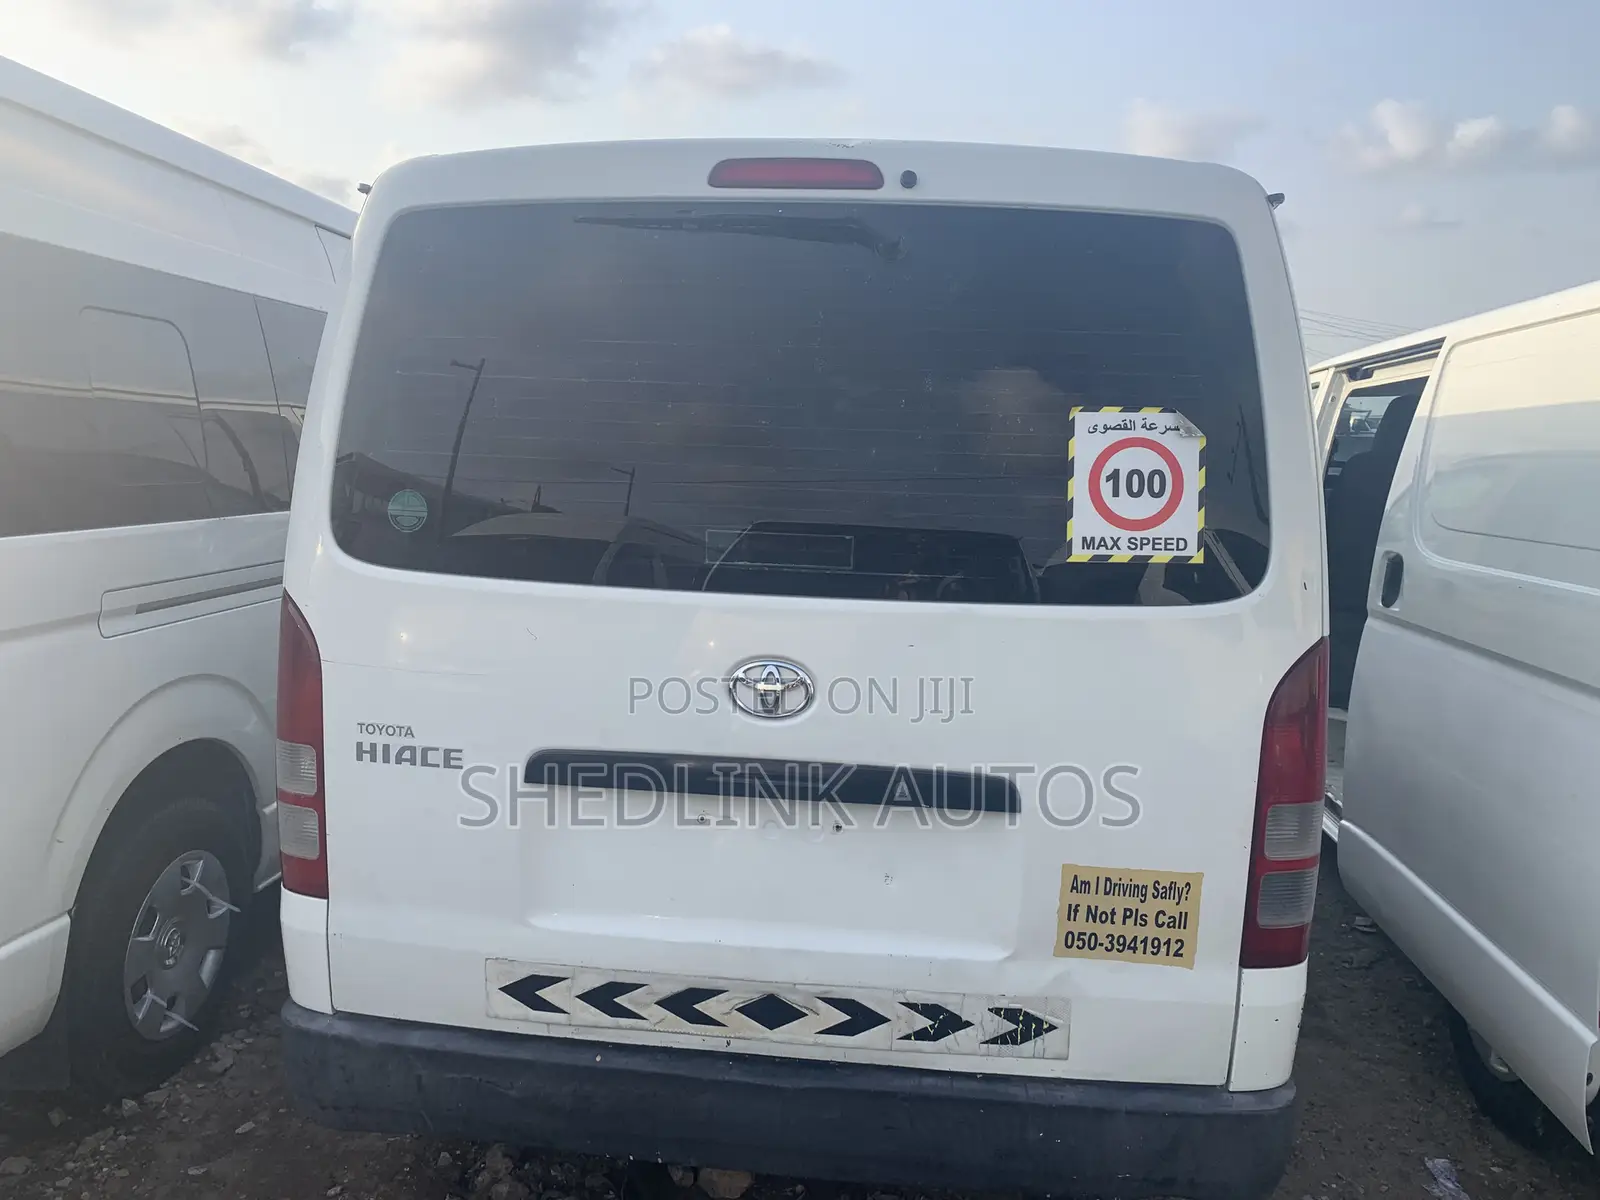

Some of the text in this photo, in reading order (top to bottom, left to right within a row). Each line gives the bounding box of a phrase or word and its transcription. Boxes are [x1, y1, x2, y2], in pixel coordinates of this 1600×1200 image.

[1088, 417, 1181, 435] سرعة القصوى
[1105, 468, 1167, 499] 100
[1081, 536, 1188, 552] MAX SPEED
[357, 722, 415, 738] TOYOTA
[356, 741, 464, 770] HIACE
[1070, 874, 1191, 906] Am I Driving Safly?
[1067, 903, 1189, 930] If Not Pls Call
[1064, 931, 1185, 958] 050-3941912
